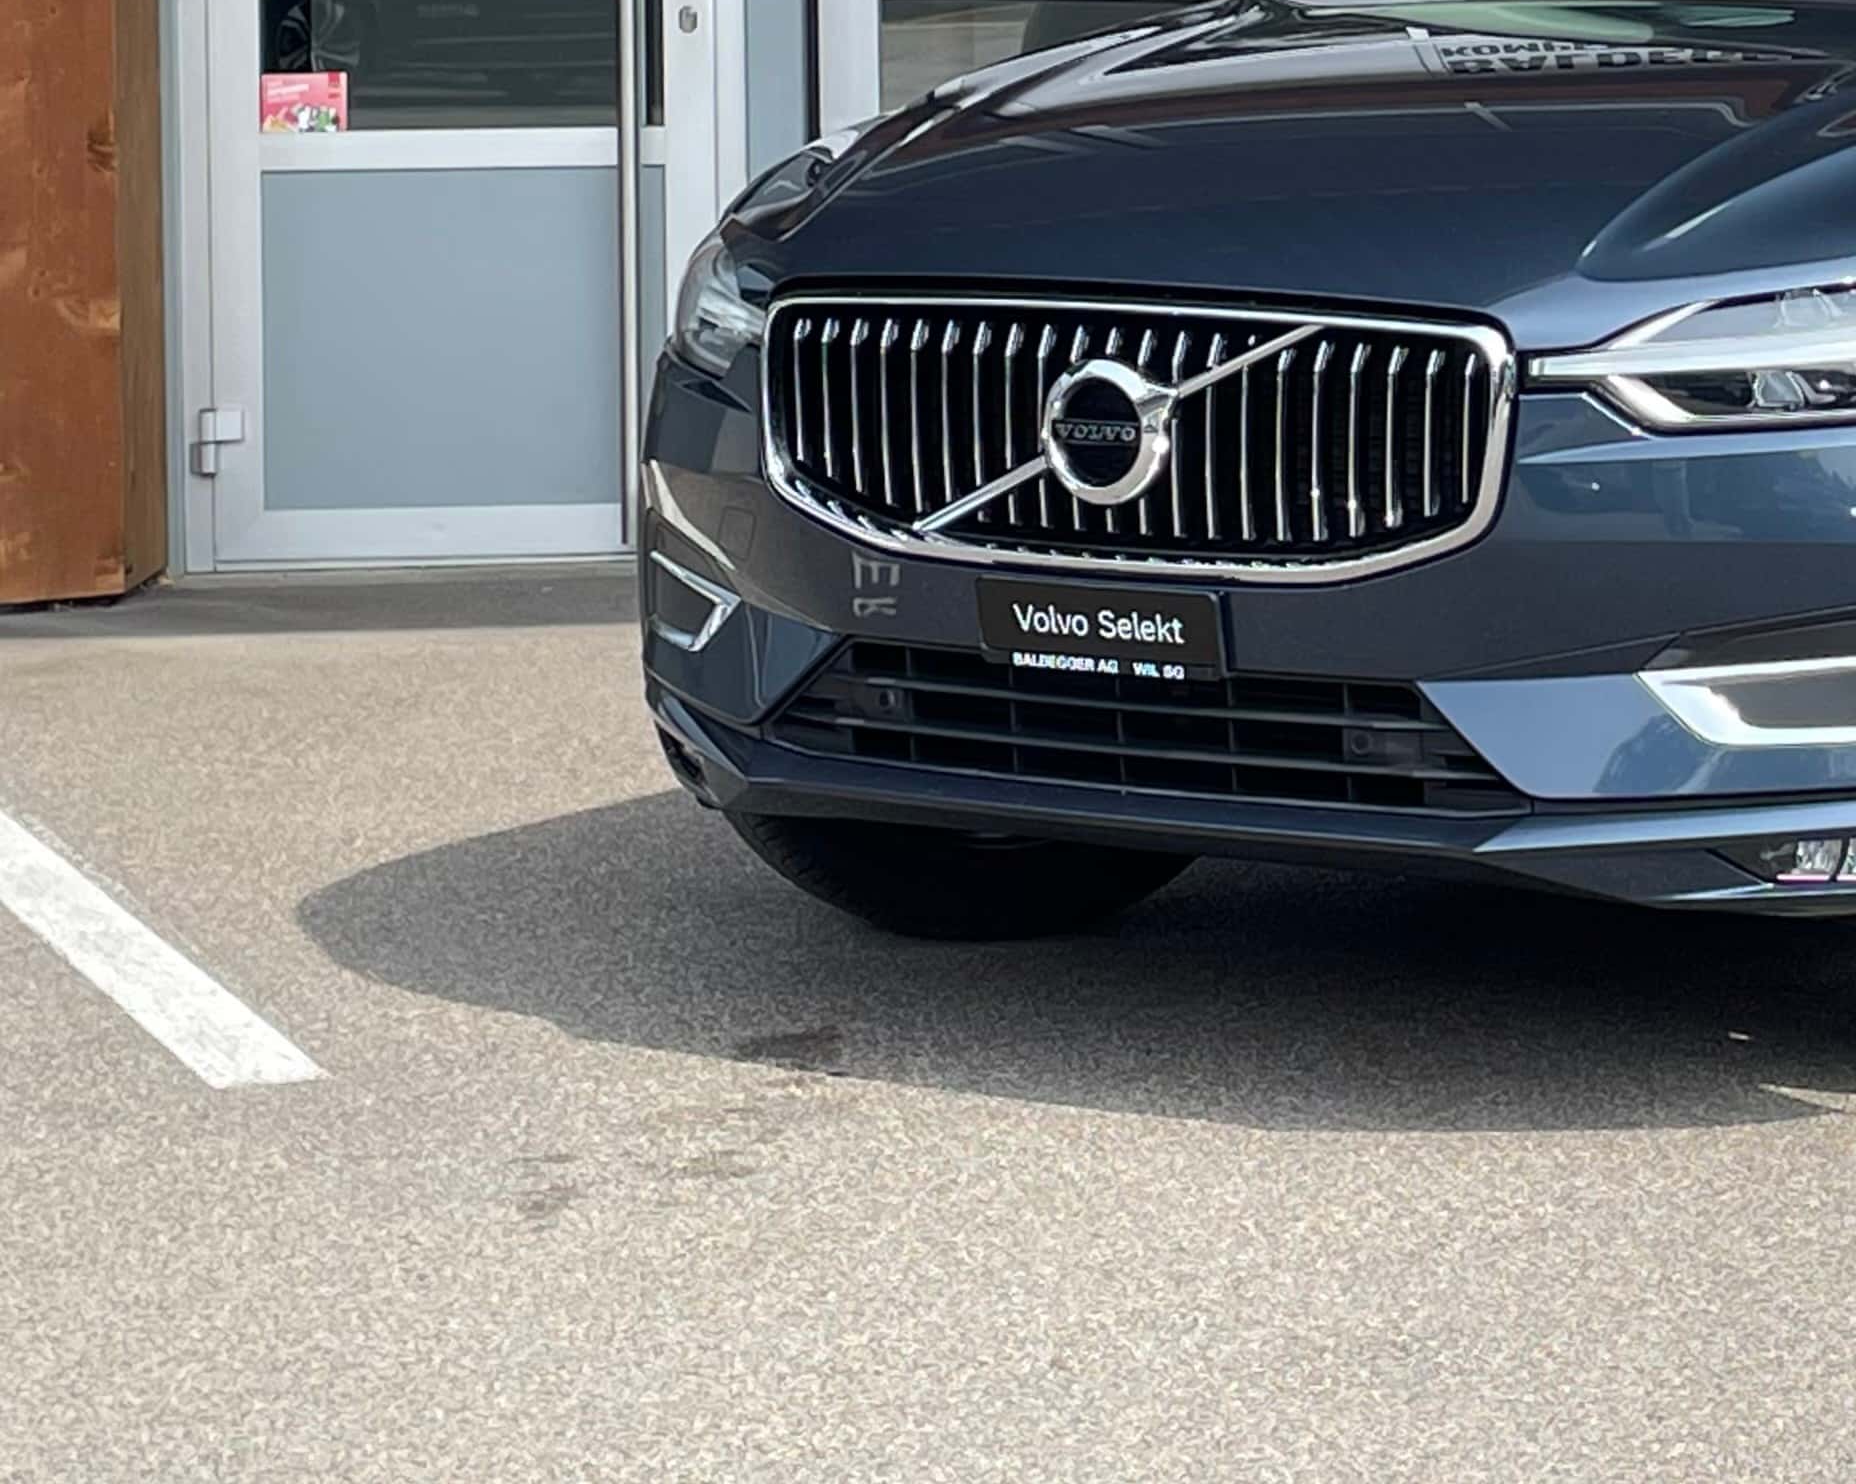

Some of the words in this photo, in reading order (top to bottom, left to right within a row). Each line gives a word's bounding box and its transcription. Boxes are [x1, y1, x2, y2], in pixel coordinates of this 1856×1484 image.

[1055, 422, 1137, 442] VOLVO
[1012, 603, 1090, 637] Volvo
[1097, 609, 1186, 645] Selekt
